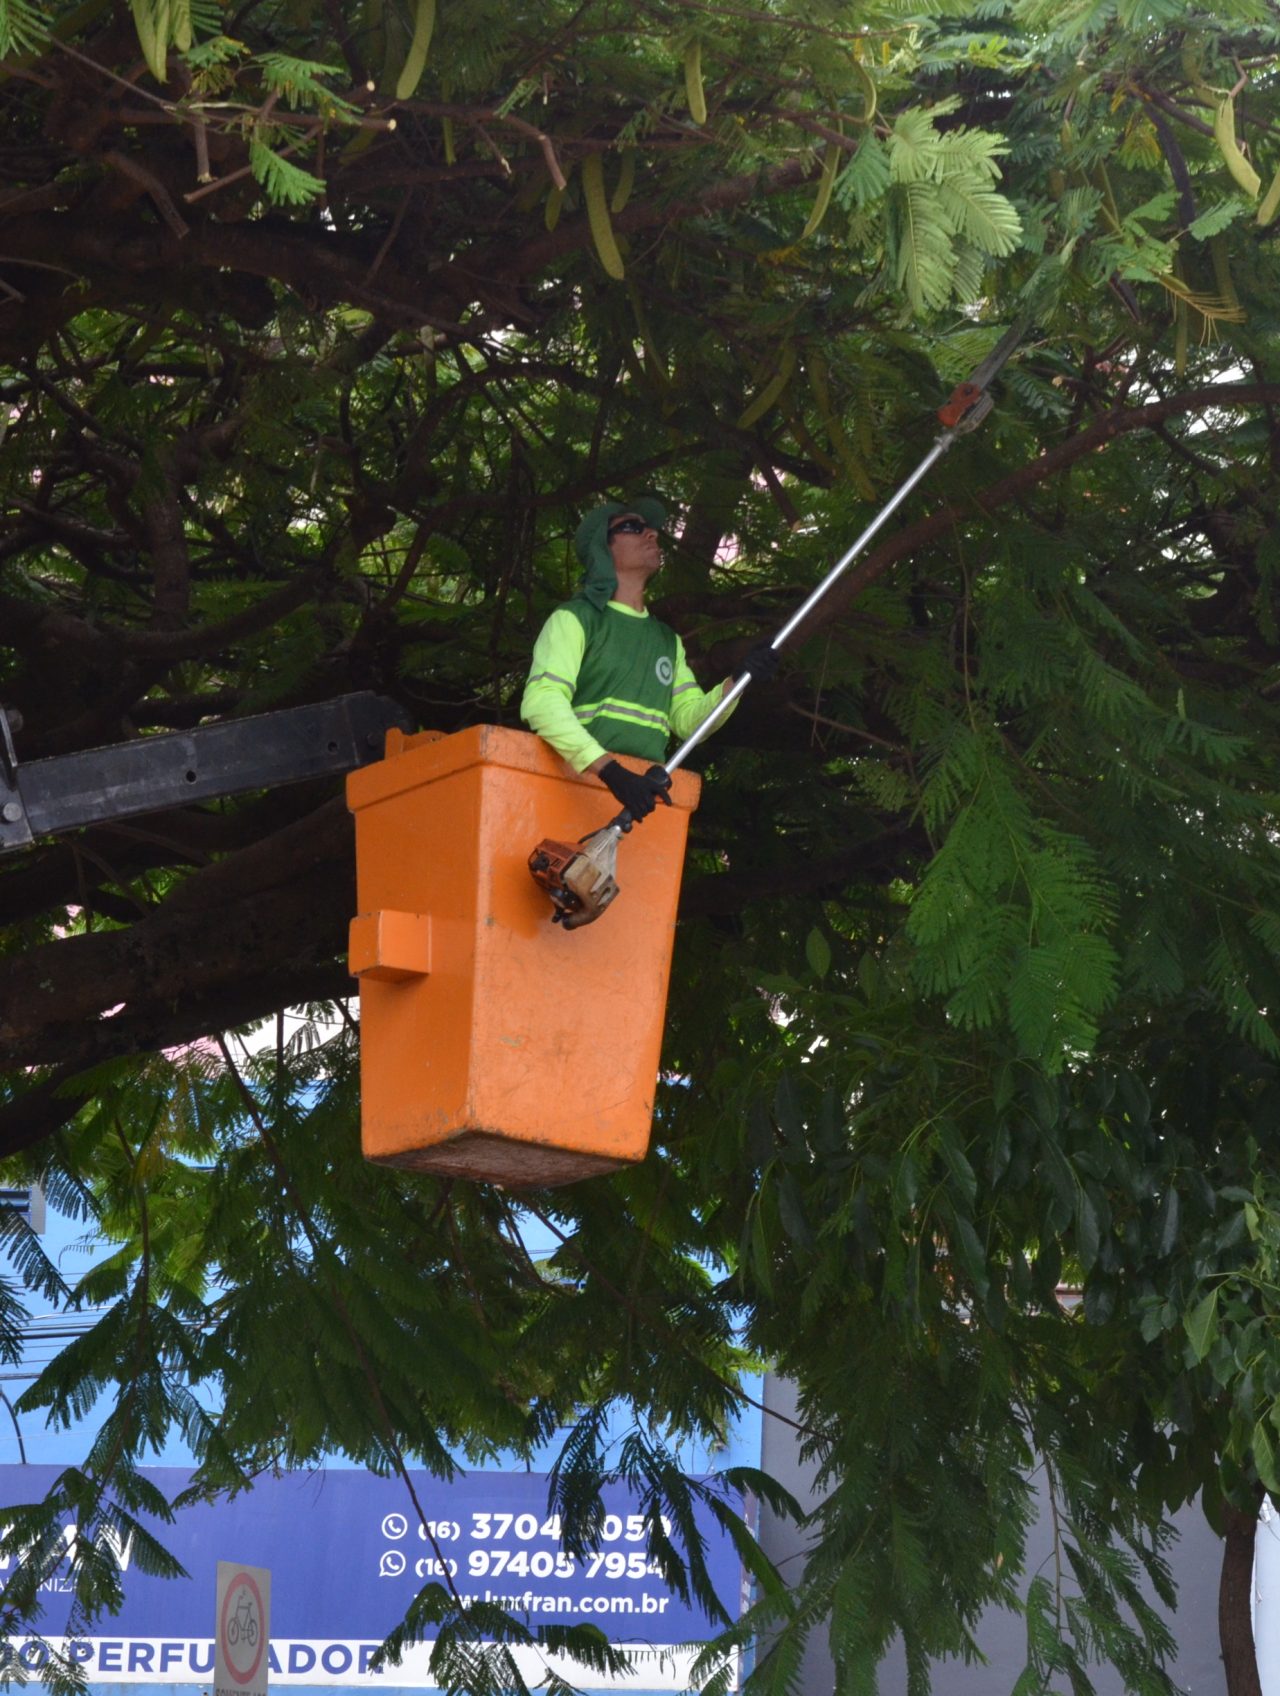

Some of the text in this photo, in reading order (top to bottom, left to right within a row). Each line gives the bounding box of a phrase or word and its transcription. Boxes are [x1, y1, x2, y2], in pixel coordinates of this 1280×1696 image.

[418, 1513, 671, 1542] (16) 3704 05
[415, 1550, 667, 1579] (16) 97405 7954
[414, 1590, 669, 1614] wluxfran.com.br
[69, 1642, 384, 1675] PERFUADOR
